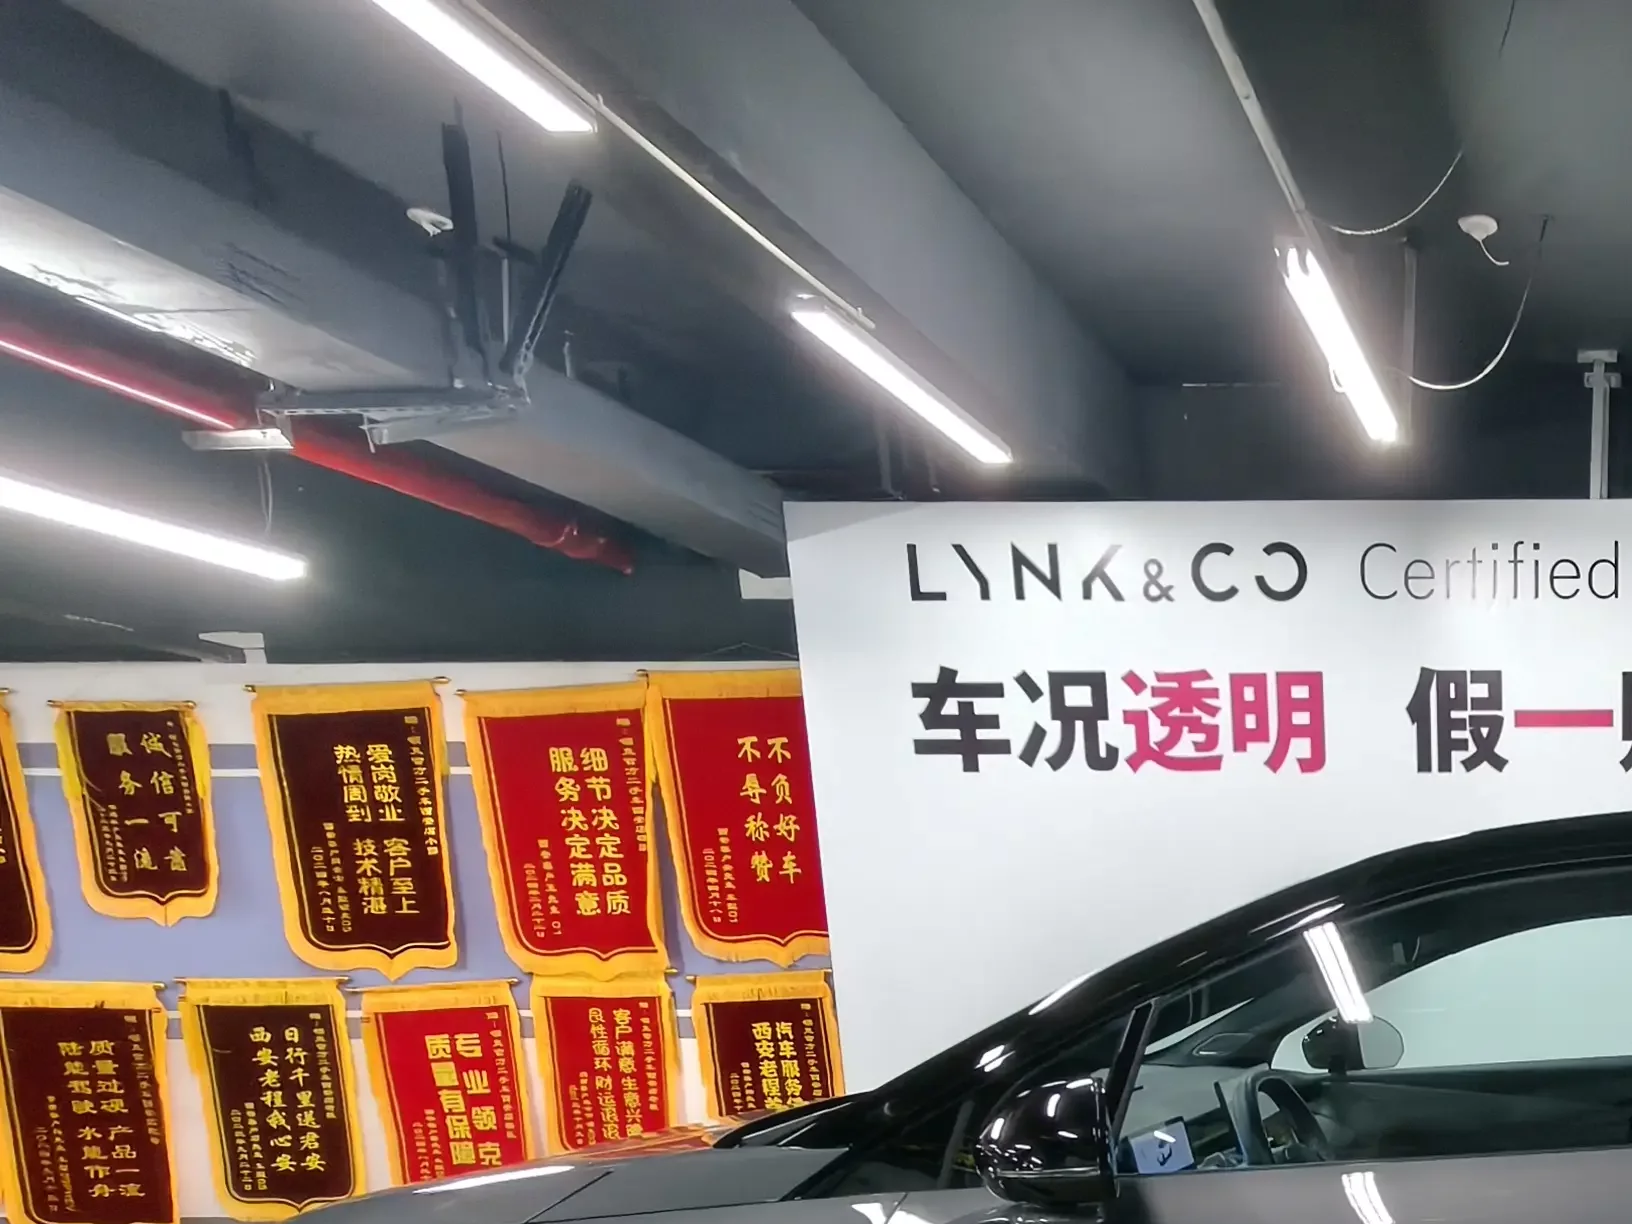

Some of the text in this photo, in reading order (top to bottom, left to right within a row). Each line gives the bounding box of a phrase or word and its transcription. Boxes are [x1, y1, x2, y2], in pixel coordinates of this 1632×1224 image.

[907, 540, 1620, 602] LYNK&CO Certified
[910, 665, 1326, 774] 车况透明
[334, 744, 372, 823] 热情周到
[353, 839, 388, 915] 技术精湛
[366, 743, 420, 915] 爱岗敬业 客户至上
[549, 747, 601, 916] 服务决定满意
[580, 747, 631, 915] 细节决定品质
[767, 736, 802, 884] 不负好车
[284, 1026, 327, 1171] 日行千里送君安
[454, 1033, 502, 1166] 专业领克
